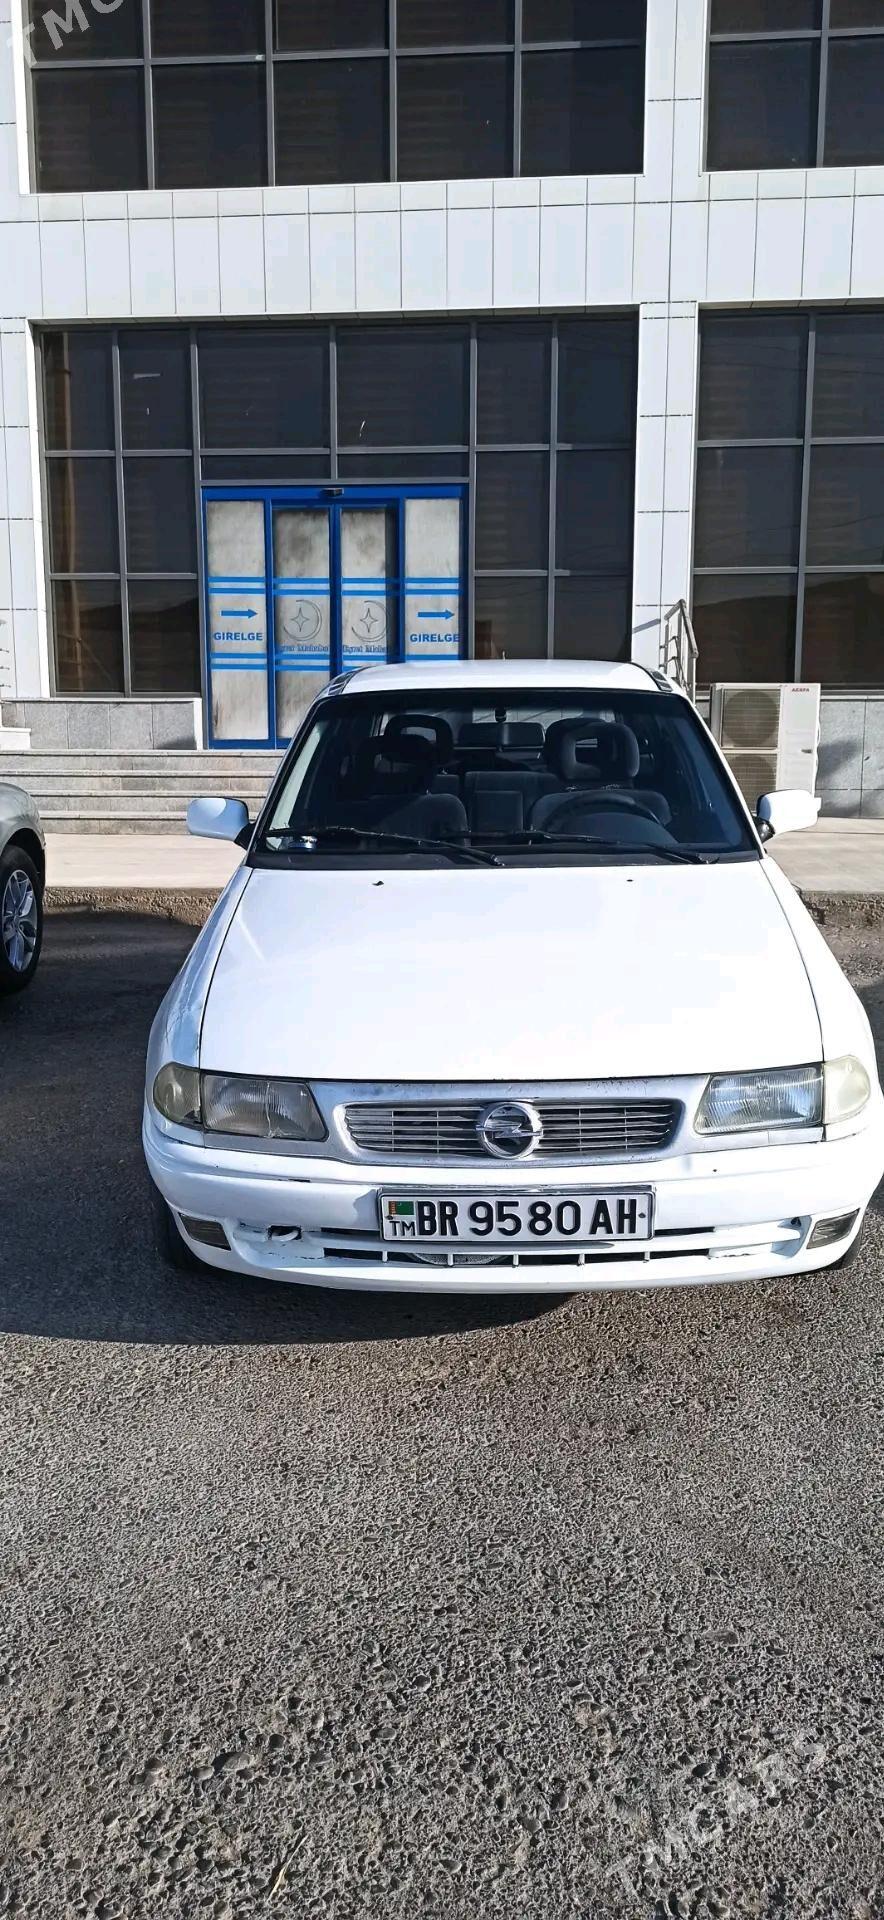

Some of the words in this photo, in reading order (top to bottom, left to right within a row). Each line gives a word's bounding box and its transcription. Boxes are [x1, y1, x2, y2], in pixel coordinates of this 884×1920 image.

[213, 632, 263, 642] GIRELGE
[410, 633, 460, 643] GIRELGE
[417, 1200, 459, 1236] BR
[589, 1199, 638, 1235] AH
[389, 1220, 416, 1237] TM
